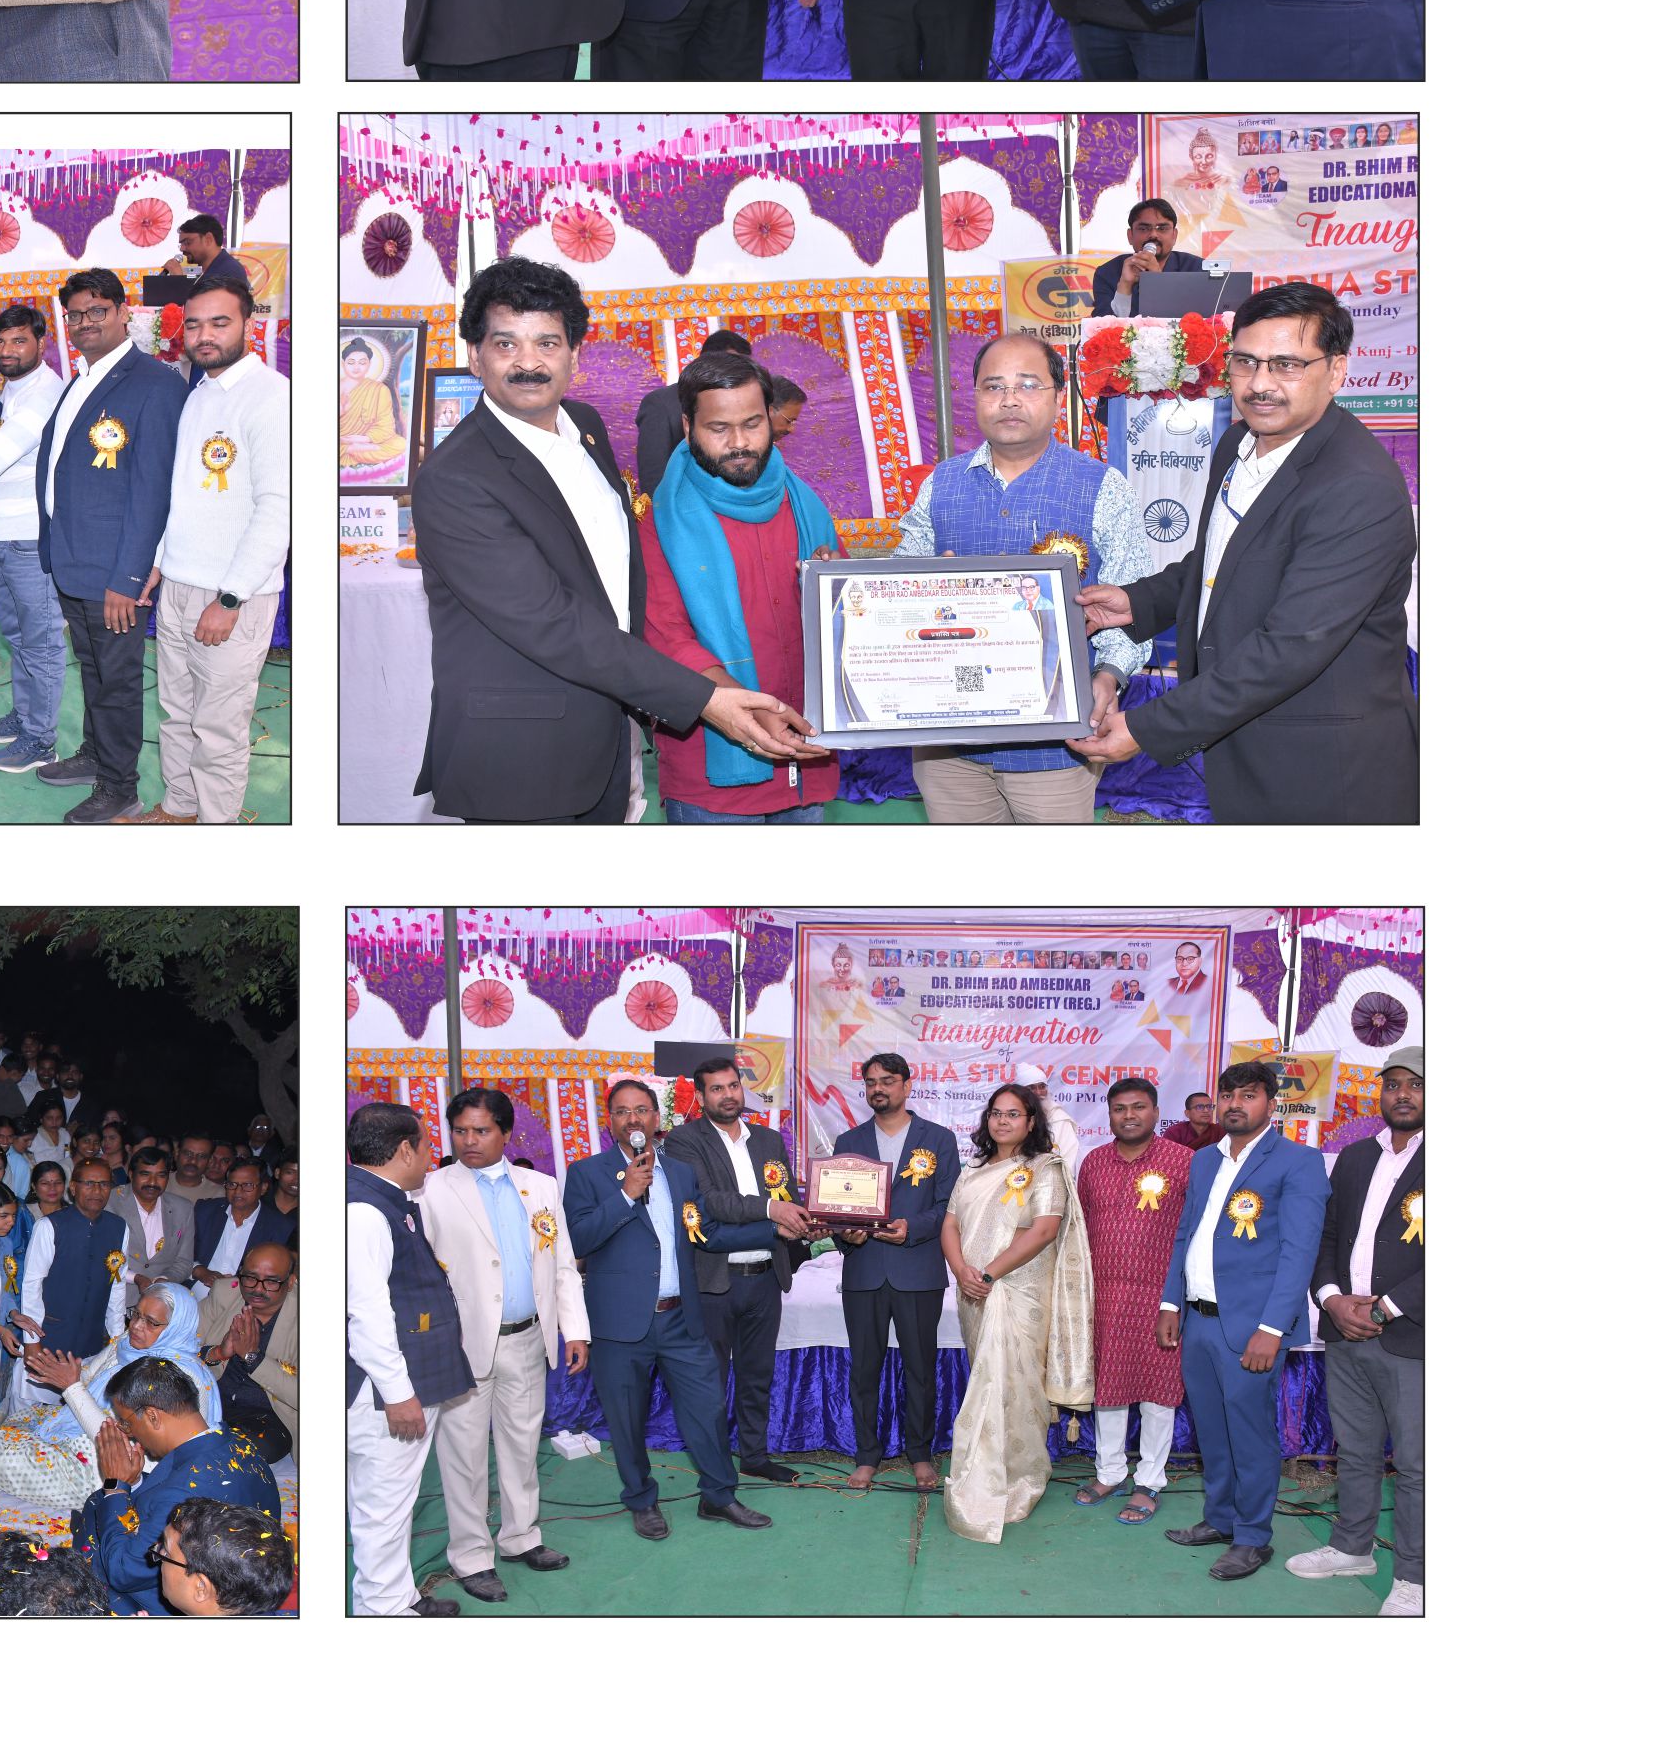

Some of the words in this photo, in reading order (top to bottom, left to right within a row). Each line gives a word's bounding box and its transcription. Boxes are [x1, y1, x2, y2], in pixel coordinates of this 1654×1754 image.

[1323, 160, 1351, 179] DR.
[1355, 157, 1403, 176] BHIM
[1054, 310, 1080, 319] GAIL
[1357, 346, 1392, 359] Kunj
[1386, 370, 1414, 390] By
[931, 976, 952, 990] DR.
[955, 976, 988, 990] BHIM
[991, 977, 1018, 991] RAO
[1020, 977, 1091, 992] AMBEDKAR
[920, 995, 1005, 1010] EDUCATIONAL
[1007, 996, 1060, 1011] SOCIETY
[1063, 997, 1101, 1012] (REG.)
[911, 1013, 1103, 1051] Inauguration
[1061, 1063, 1161, 1087] CENTER
[944, 1089, 992, 1103] Sunday
[1075, 1091, 1097, 1103] PM
